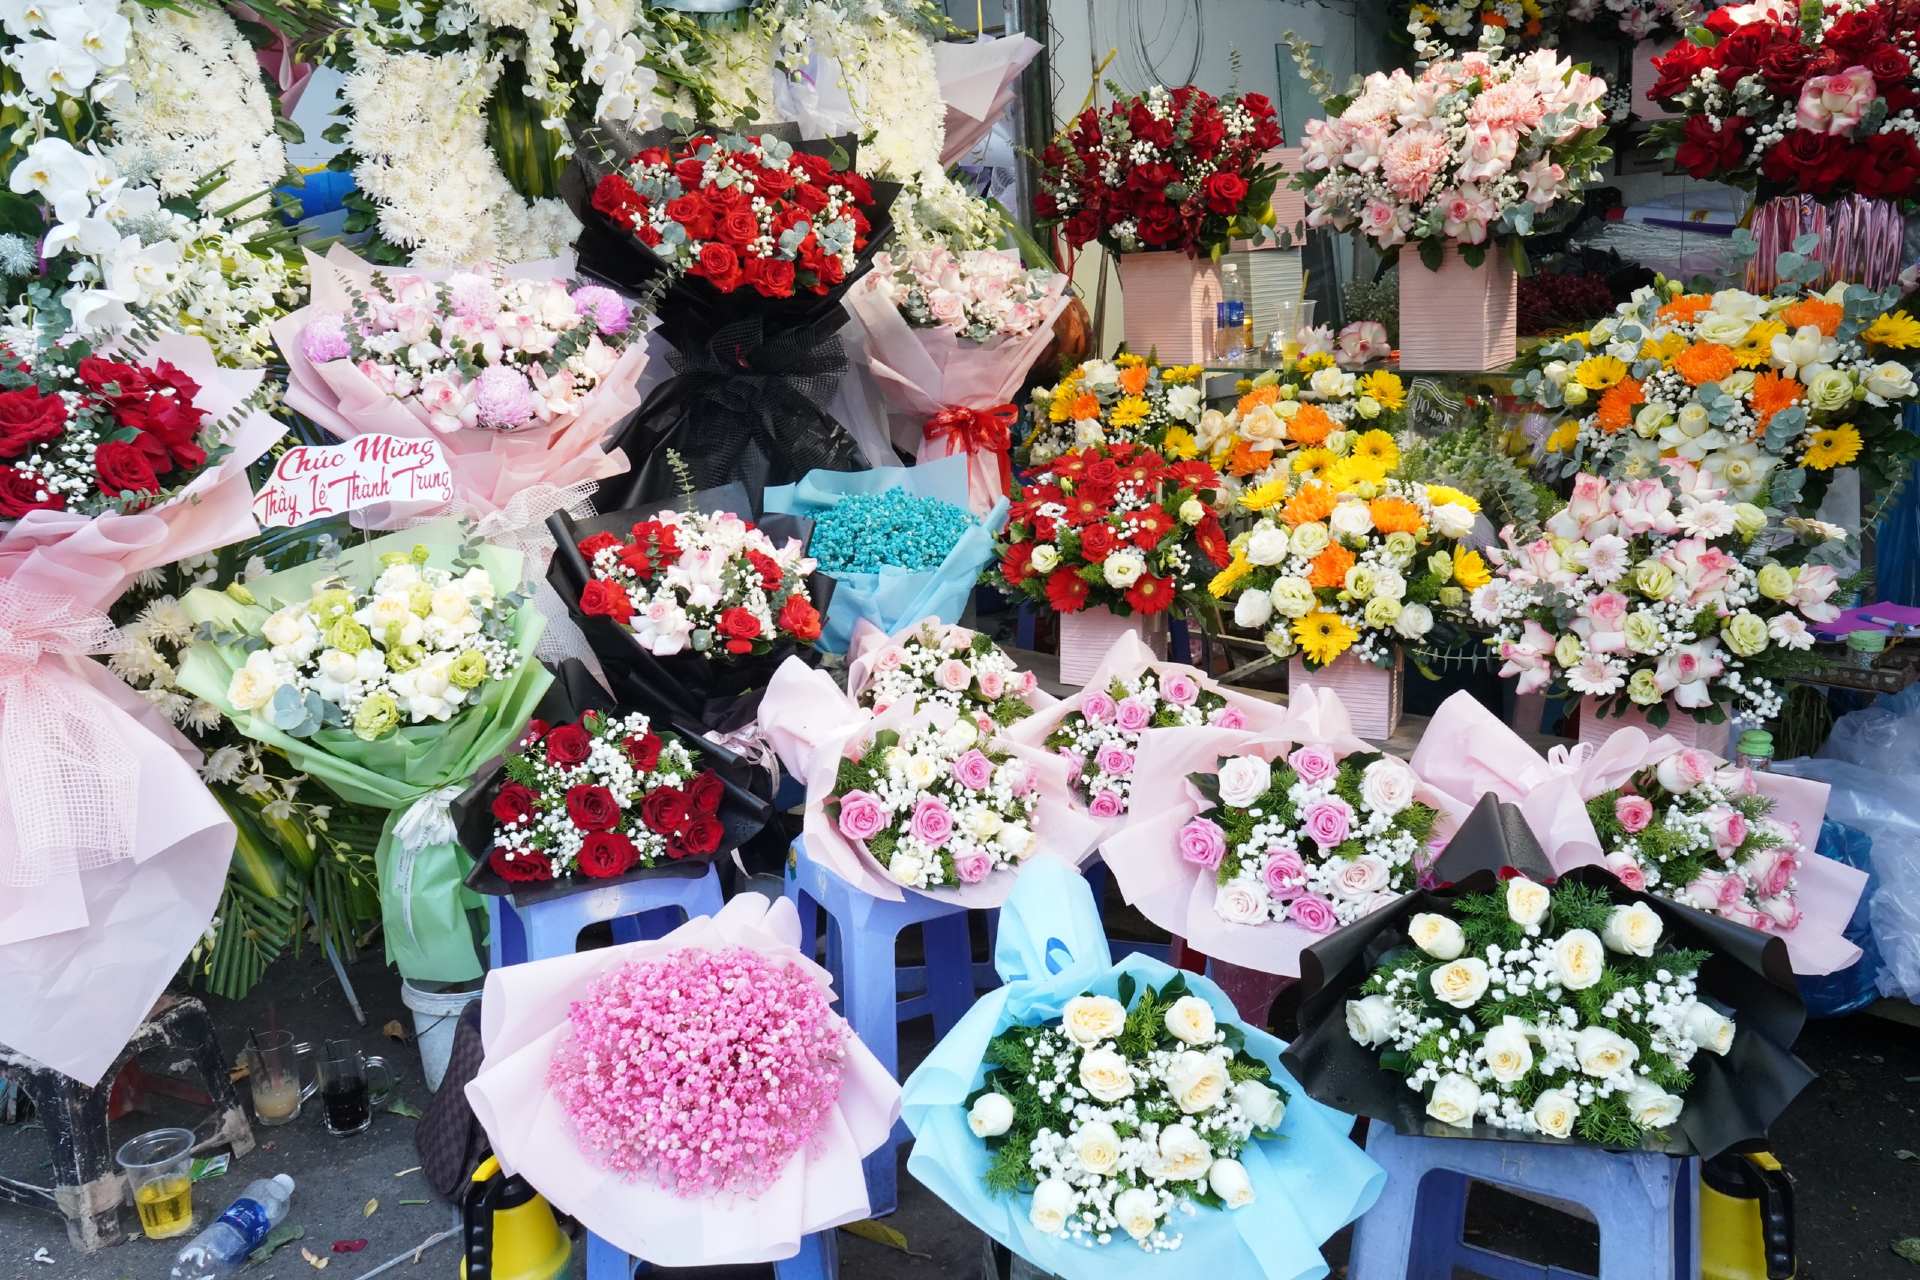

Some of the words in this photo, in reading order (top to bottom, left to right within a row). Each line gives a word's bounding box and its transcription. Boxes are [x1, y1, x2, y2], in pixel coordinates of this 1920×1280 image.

[277, 447, 345, 481] Chúc
[354, 435, 435, 466] Mừng
[253, 485, 303, 526] Thầy
[309, 475, 332, 516] Lê
[328, 466, 390, 509] Thành
[392, 465, 451, 501] Trung
